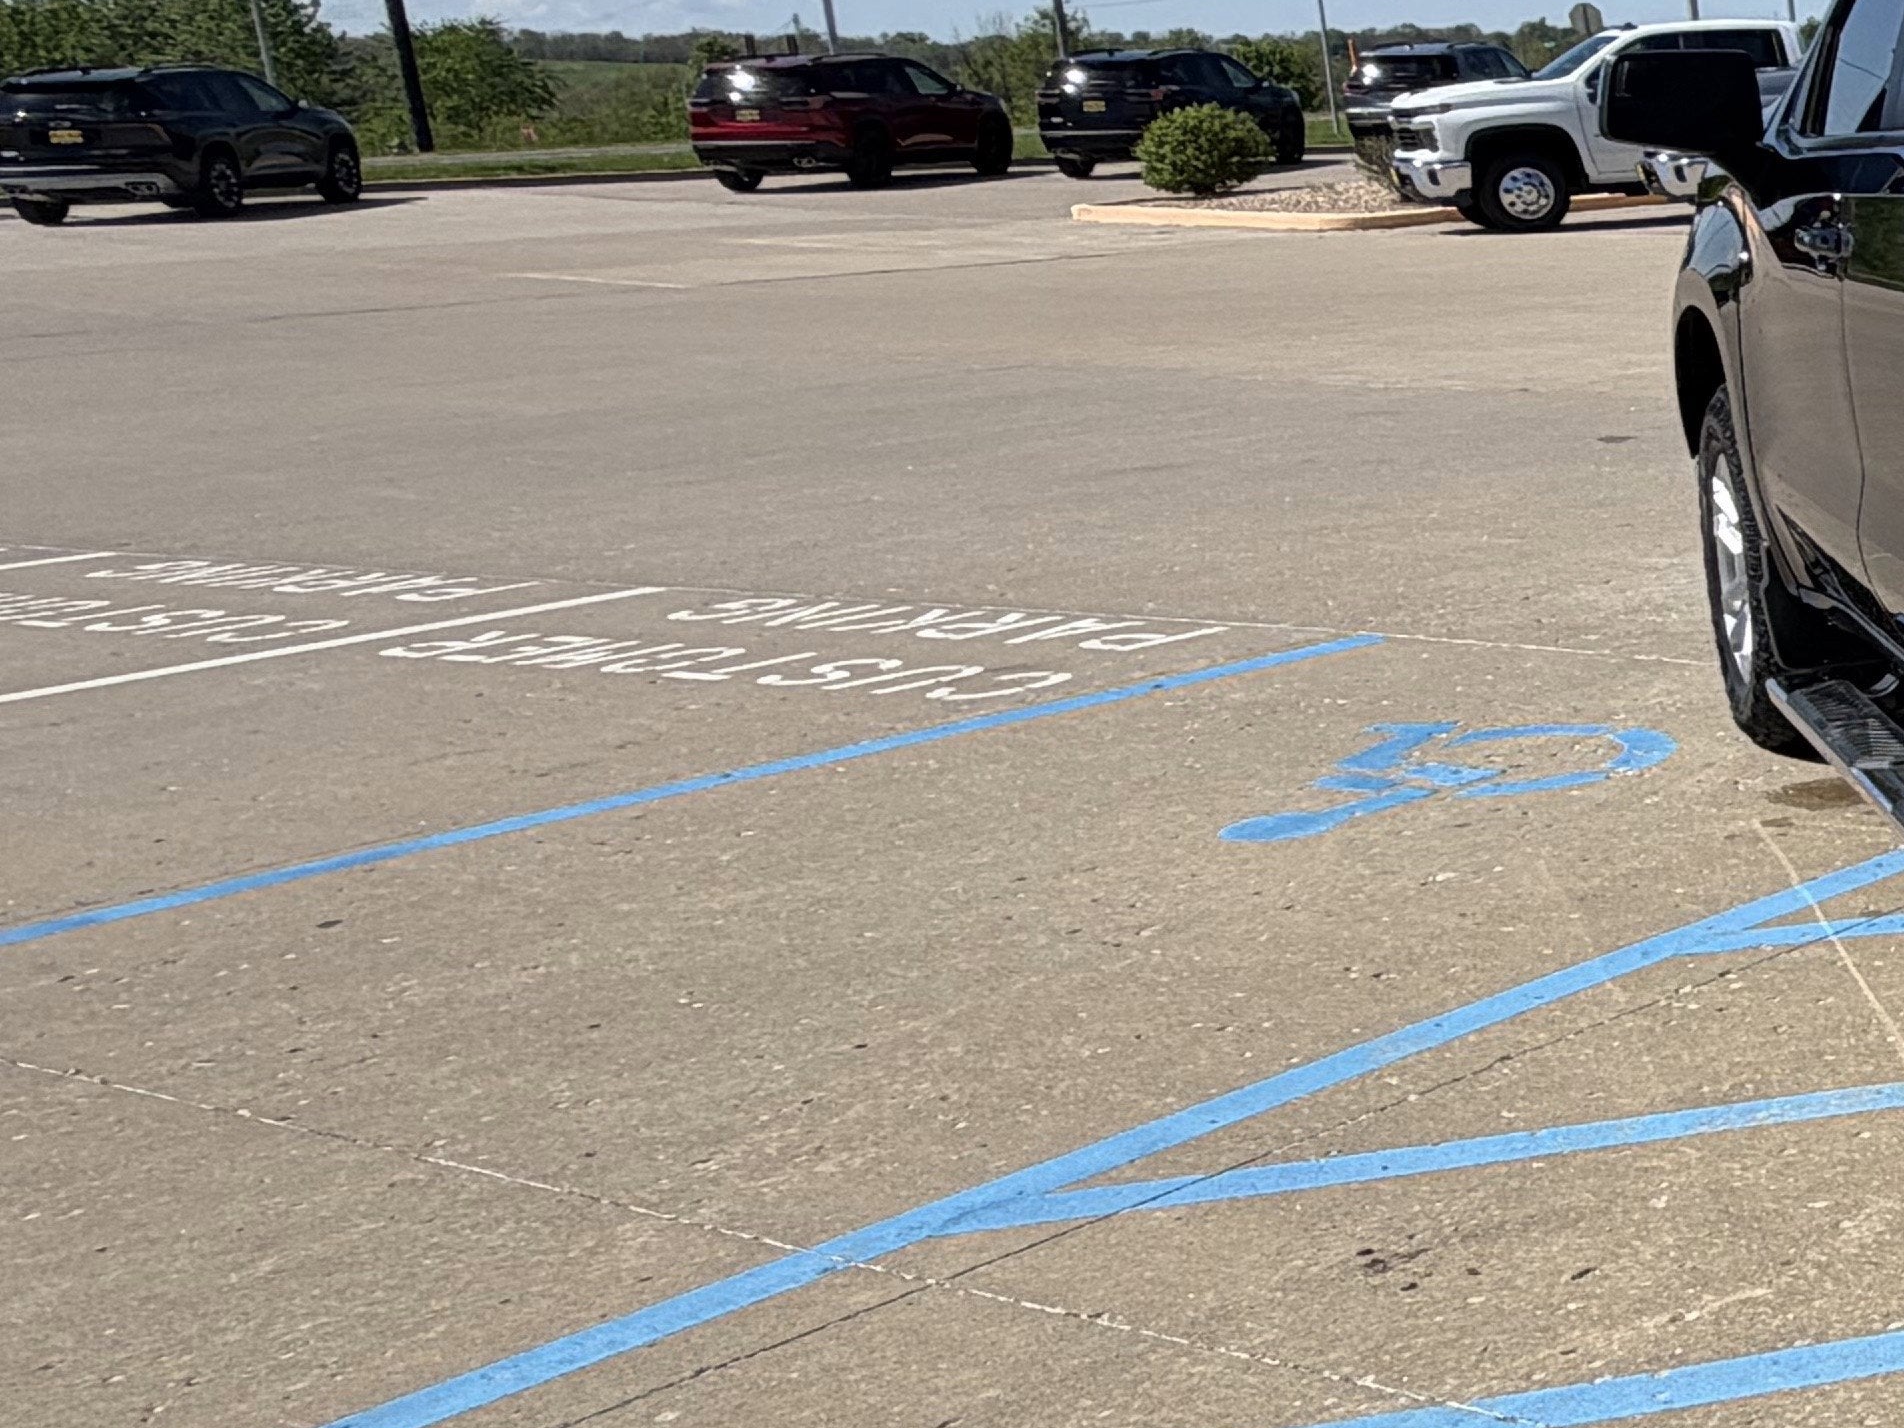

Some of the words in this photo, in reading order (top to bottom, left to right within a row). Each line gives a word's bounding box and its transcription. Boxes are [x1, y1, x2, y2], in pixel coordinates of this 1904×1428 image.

[85, 560, 542, 602] PARKING
[667, 598, 1231, 651] PARKING
[378, 630, 1073, 702] CUSTOMER
